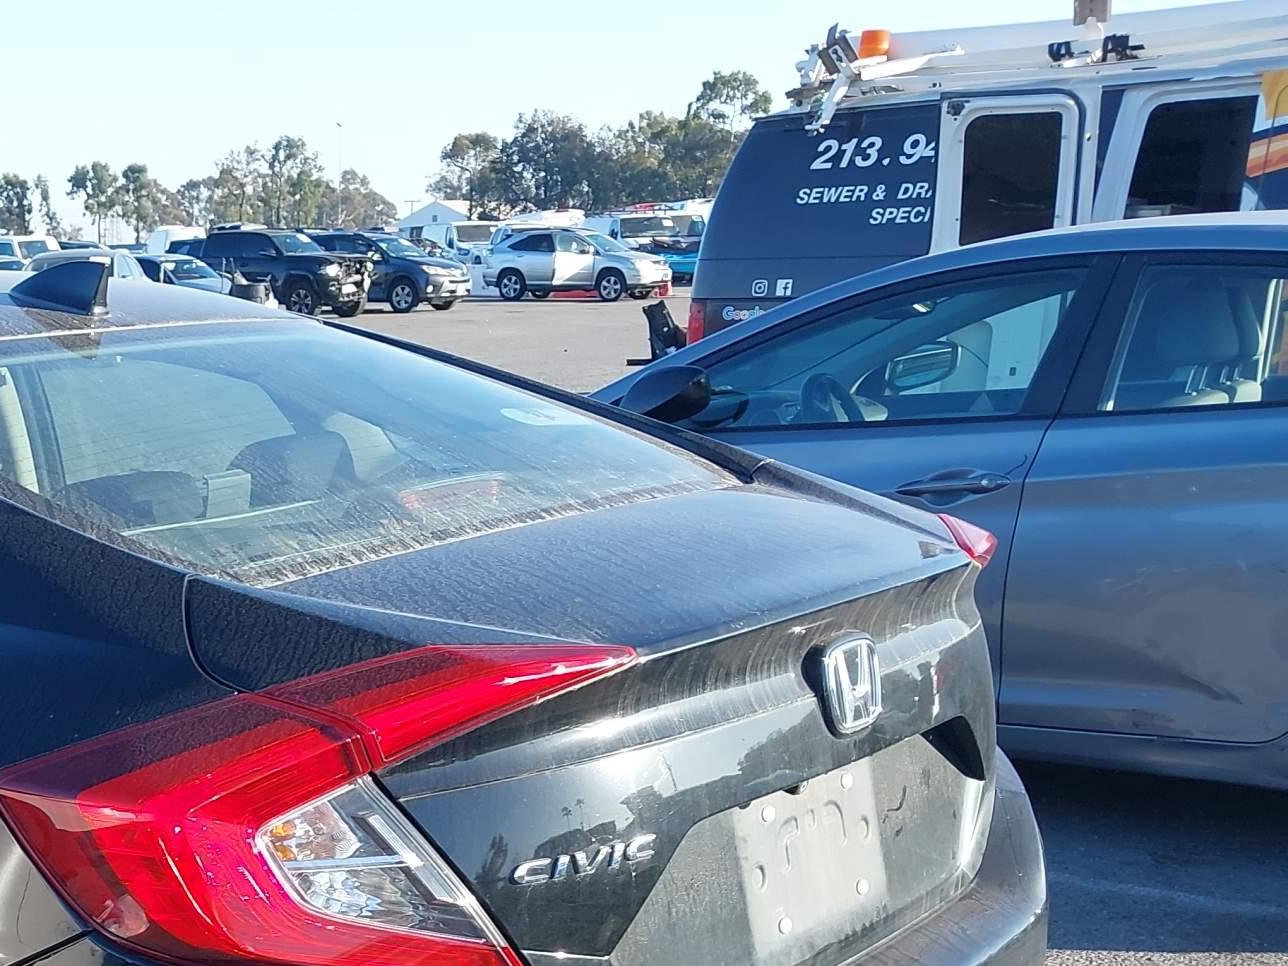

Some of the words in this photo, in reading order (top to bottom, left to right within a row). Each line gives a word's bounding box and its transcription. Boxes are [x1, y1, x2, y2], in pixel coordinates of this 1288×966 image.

[796, 185, 869, 204] SEWER
[872, 184, 886, 200] &
[509, 833, 657, 885] CIVIC
